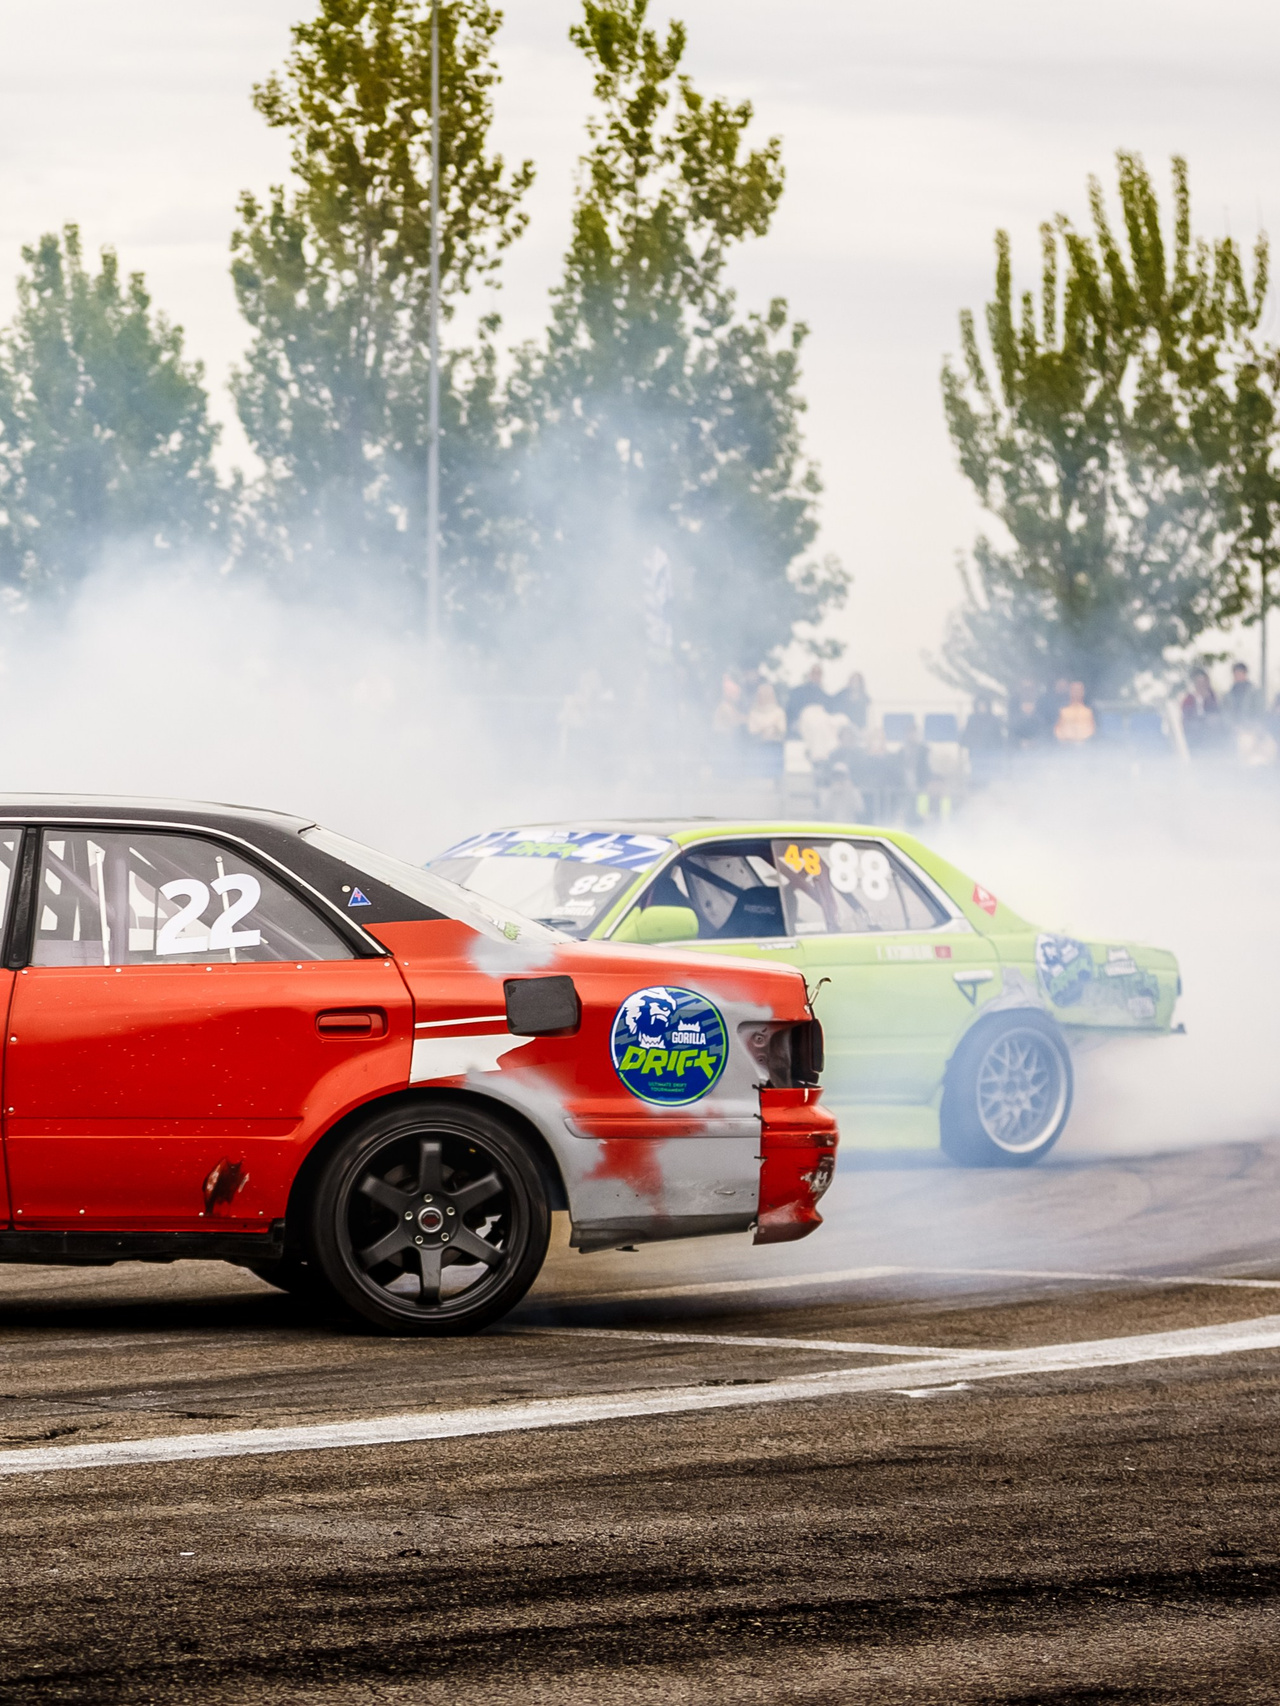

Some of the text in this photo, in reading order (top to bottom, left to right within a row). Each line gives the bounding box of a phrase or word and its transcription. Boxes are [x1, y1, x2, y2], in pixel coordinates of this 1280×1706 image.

[784, 844, 822, 876] 48
[829, 841, 891, 901] 88
[568, 872, 622, 895] 88
[156, 873, 261, 955] 22
[671, 1031, 706, 1045] GORILLA
[620, 1045, 717, 1079] DRIFT
